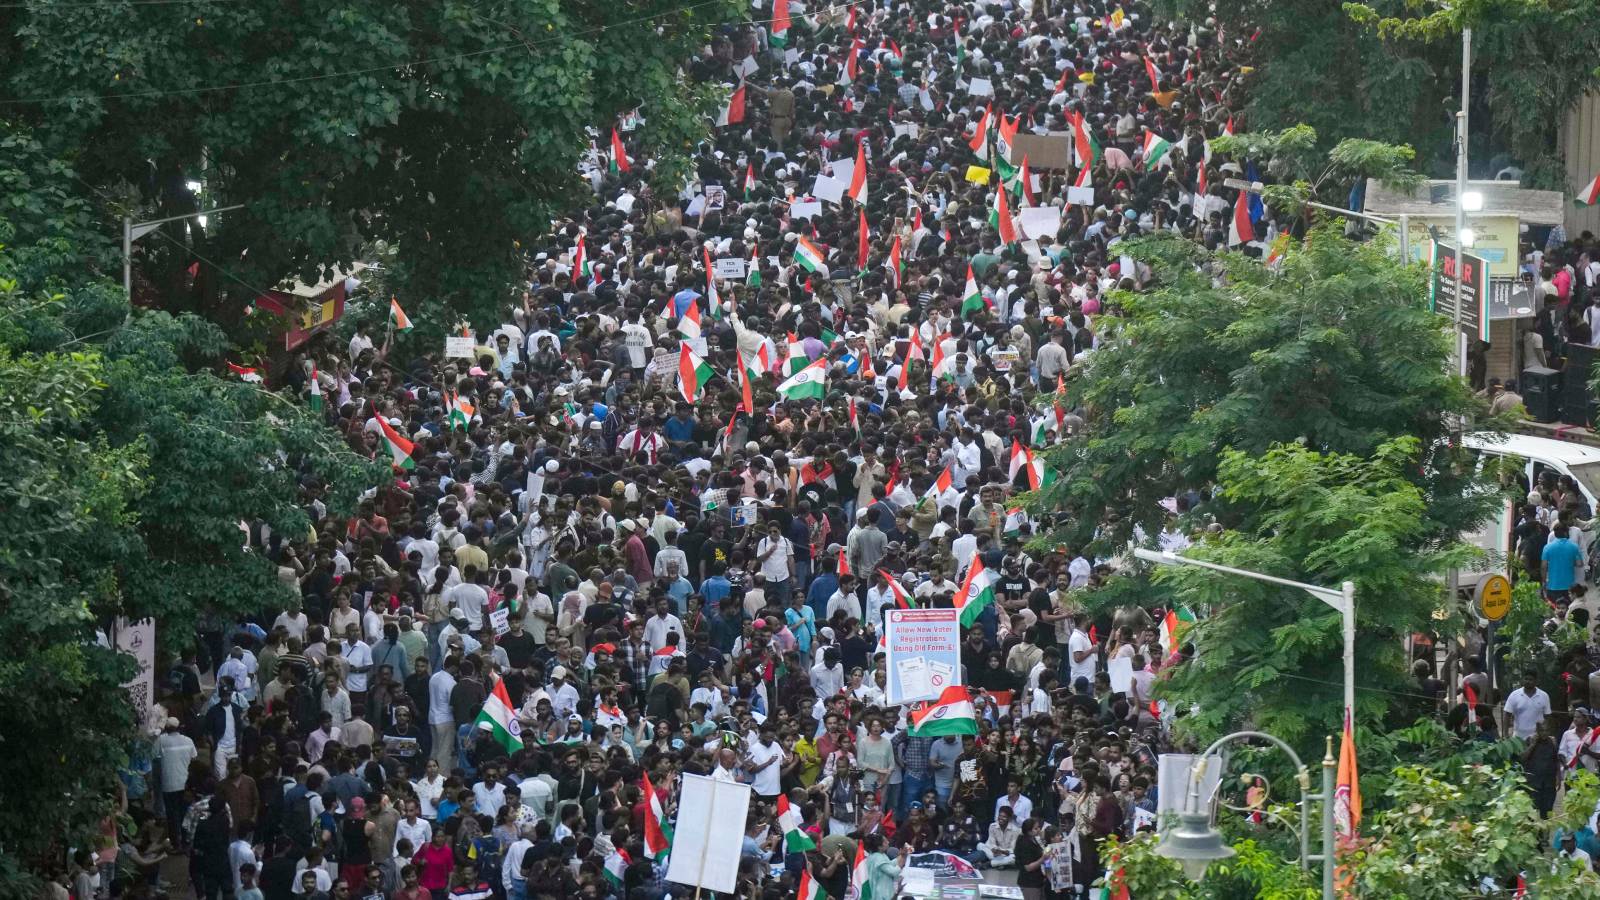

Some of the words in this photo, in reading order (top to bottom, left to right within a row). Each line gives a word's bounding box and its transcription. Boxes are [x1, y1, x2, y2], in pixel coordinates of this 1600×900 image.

[1444, 256, 1473, 284] ROR
[900, 635, 946, 643] Registrations
[893, 644, 913, 652] Using
